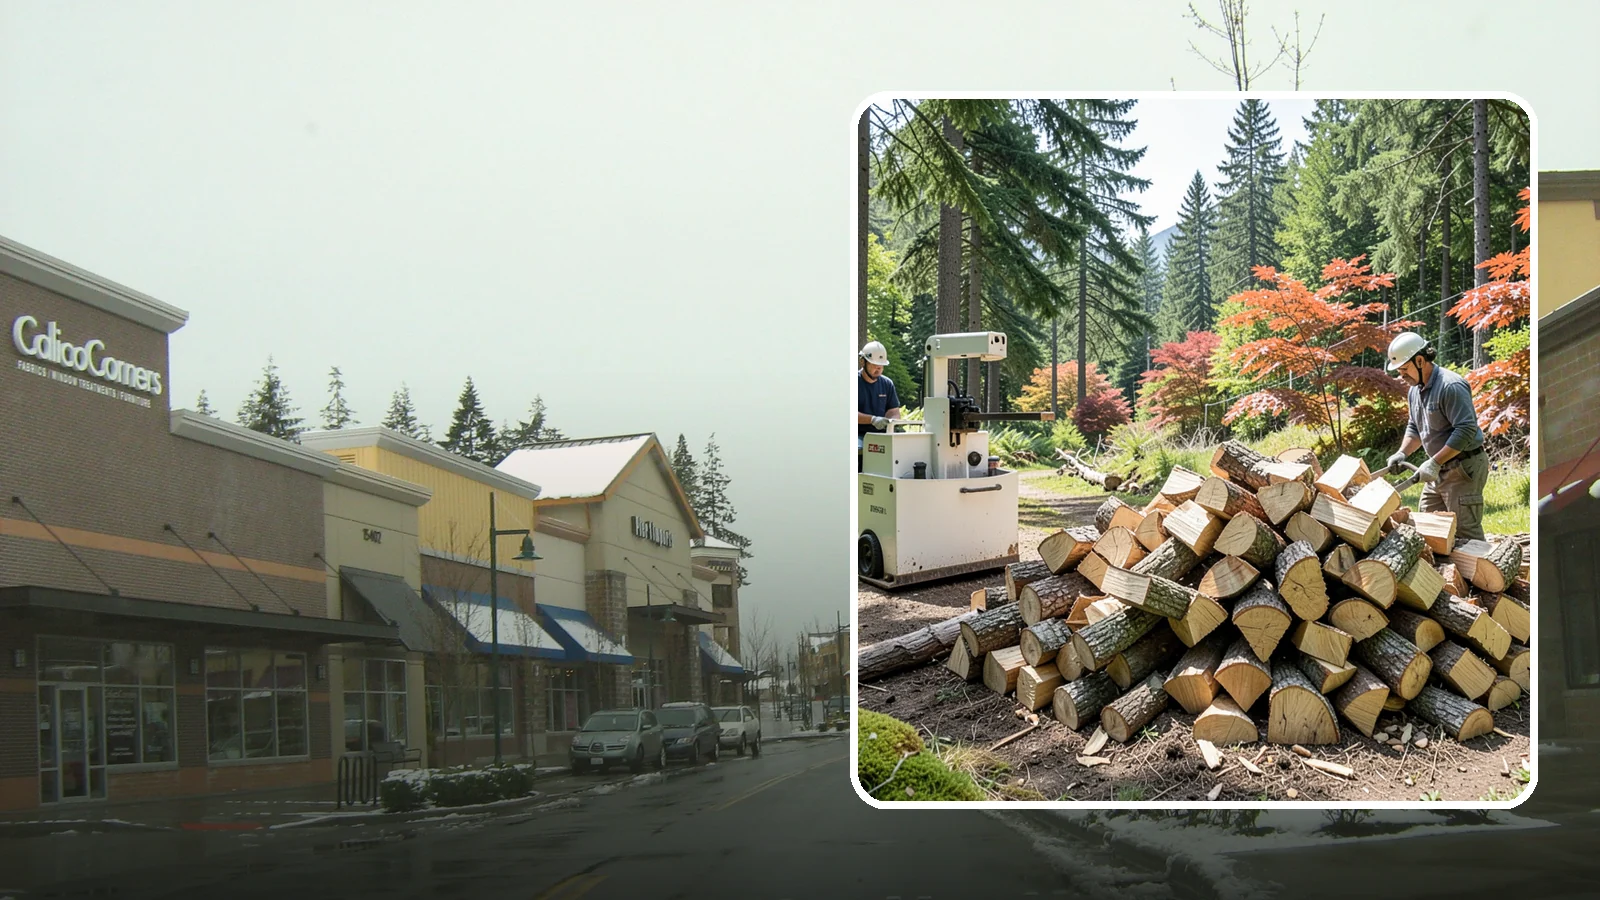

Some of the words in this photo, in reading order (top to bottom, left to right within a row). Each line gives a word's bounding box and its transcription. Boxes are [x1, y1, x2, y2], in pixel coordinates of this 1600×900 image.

[12, 315, 162, 395] CalicoCorners
[17, 360, 47, 377] FABRICS
[51, 370, 78, 386] WINDOW
[78, 378, 116, 398] TREATMENTS
[120, 391, 151, 408] FURNITURE
